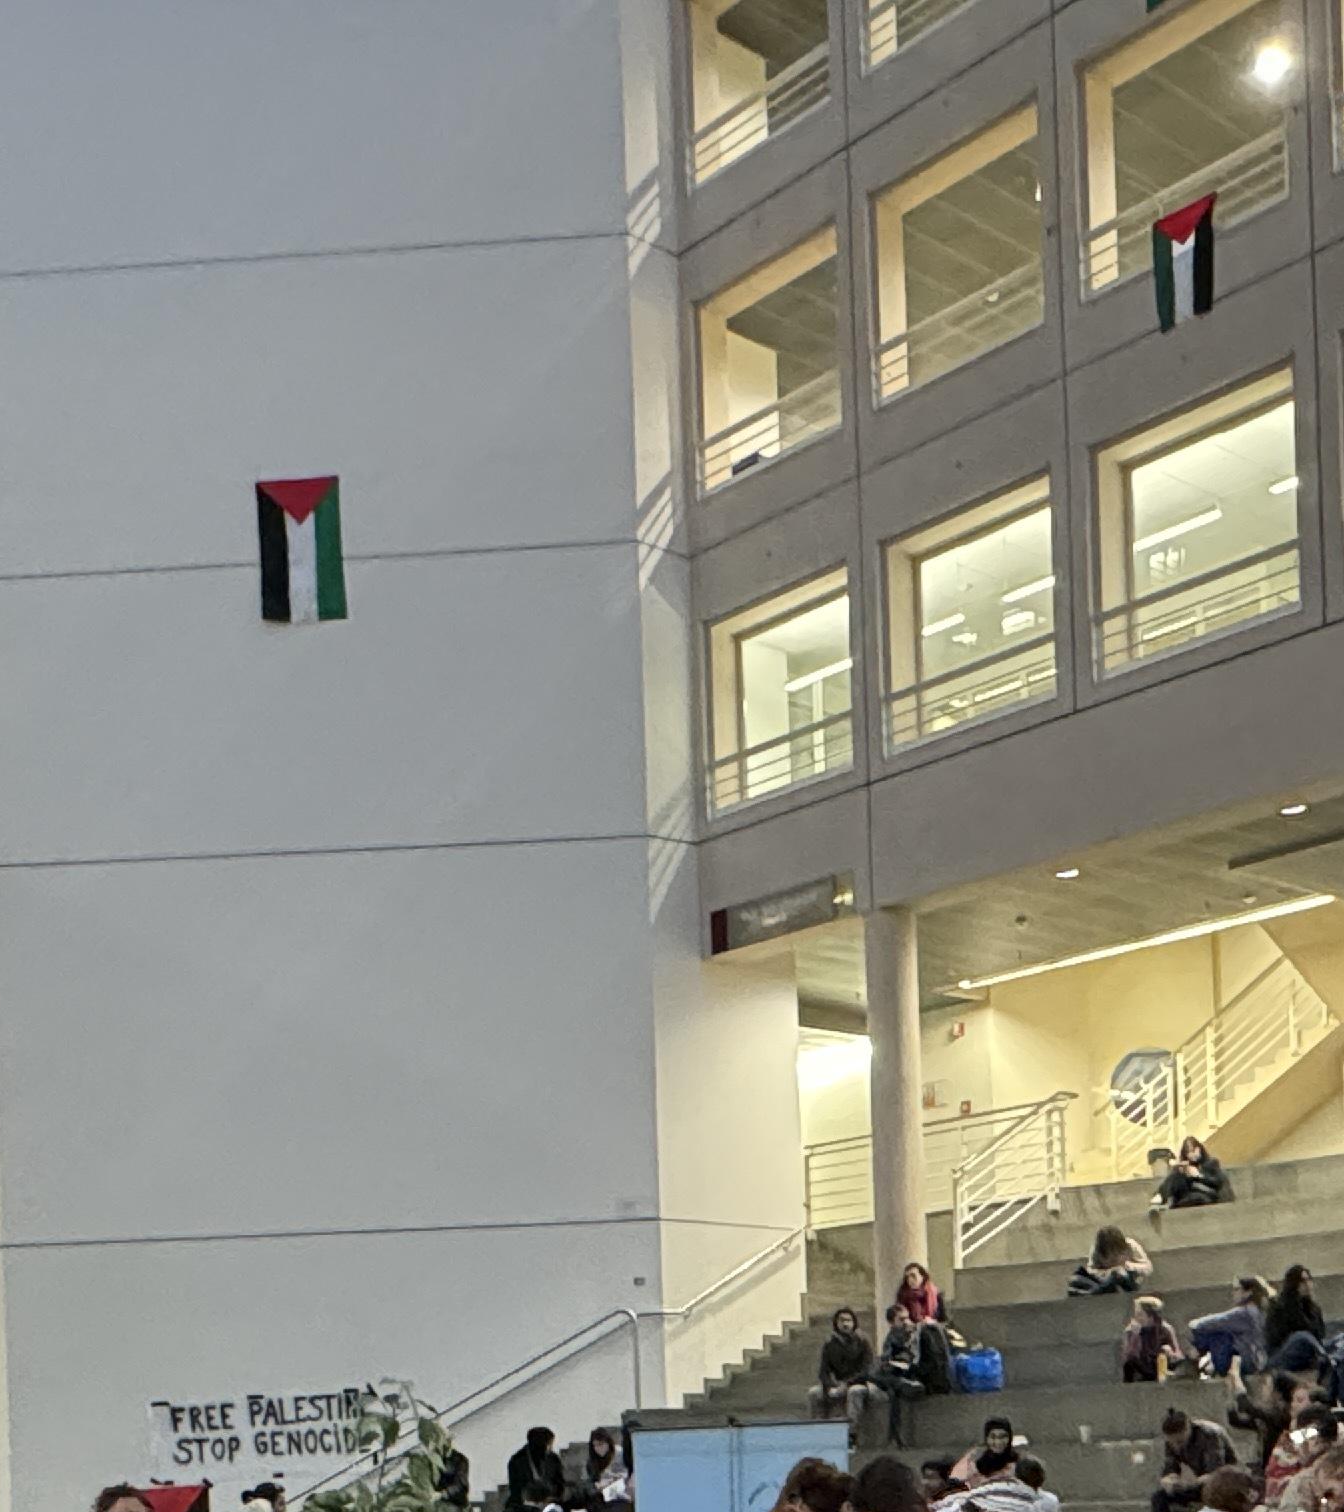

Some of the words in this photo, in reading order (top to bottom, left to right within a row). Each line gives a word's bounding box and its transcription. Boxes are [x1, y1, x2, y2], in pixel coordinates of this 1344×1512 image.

[170, 1403, 236, 1433] FREE
[248, 1391, 372, 1427] PALESTIN
[173, 1436, 241, 1465] STOP
